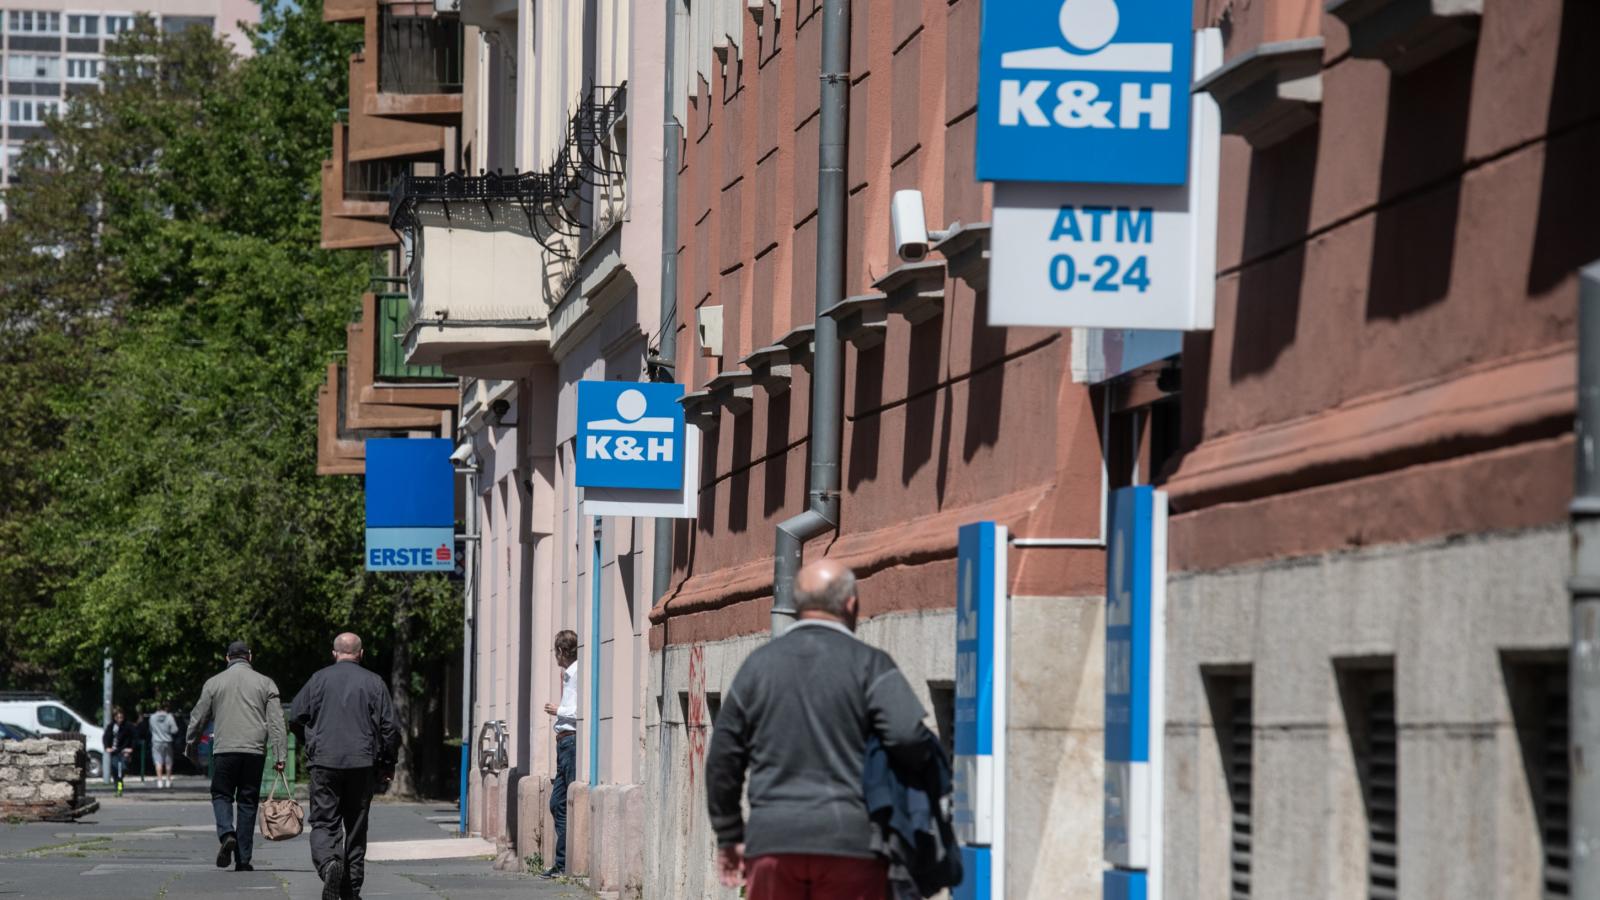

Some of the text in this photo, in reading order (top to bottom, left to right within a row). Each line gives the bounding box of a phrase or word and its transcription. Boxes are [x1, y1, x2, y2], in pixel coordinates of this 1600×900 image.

[998, 79, 1172, 130] K&H
[1048, 204, 1154, 244] ATM
[1048, 252, 1151, 294] 0-24
[586, 435, 674, 462] K&H
[369, 548, 433, 566] ERSTE
